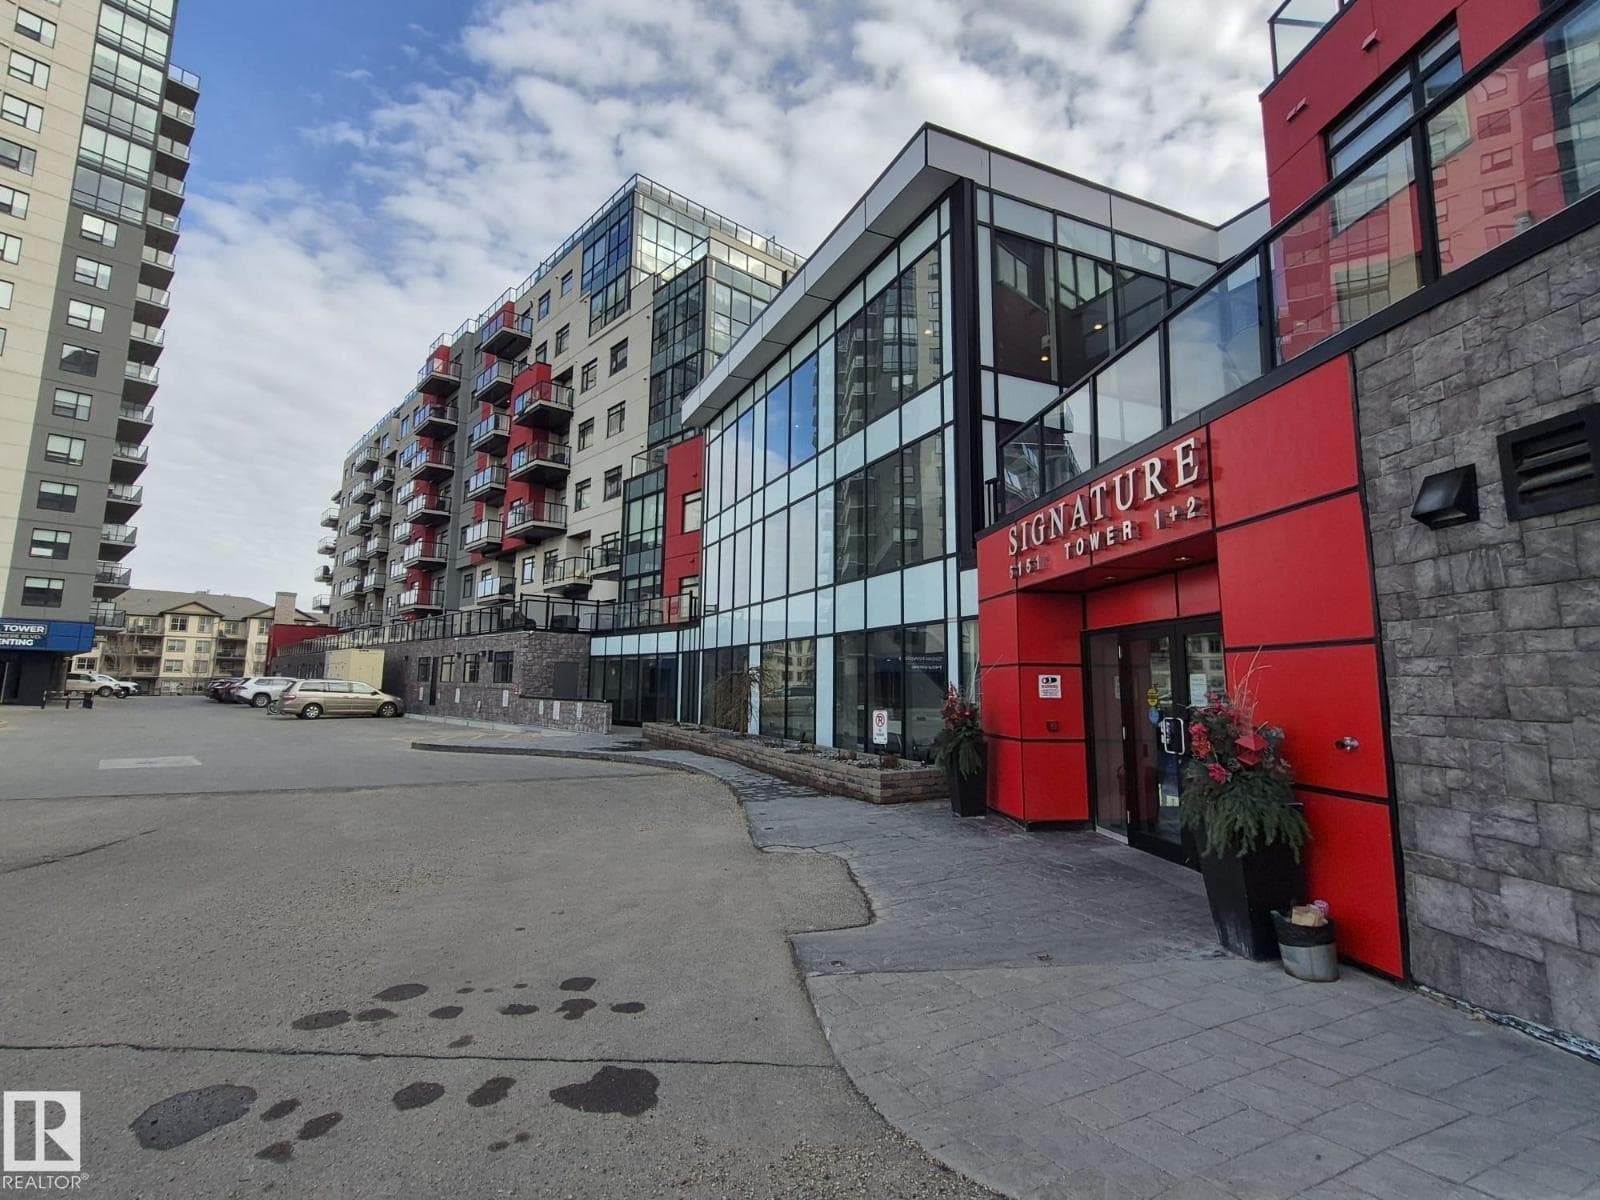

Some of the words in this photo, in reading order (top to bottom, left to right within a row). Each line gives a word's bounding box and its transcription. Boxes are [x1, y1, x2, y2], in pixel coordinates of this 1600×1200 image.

[1008, 437, 1199, 555] SIGNATURE
[1064, 520, 1132, 560] TOWER
[3, 624, 45, 633] TOWER
